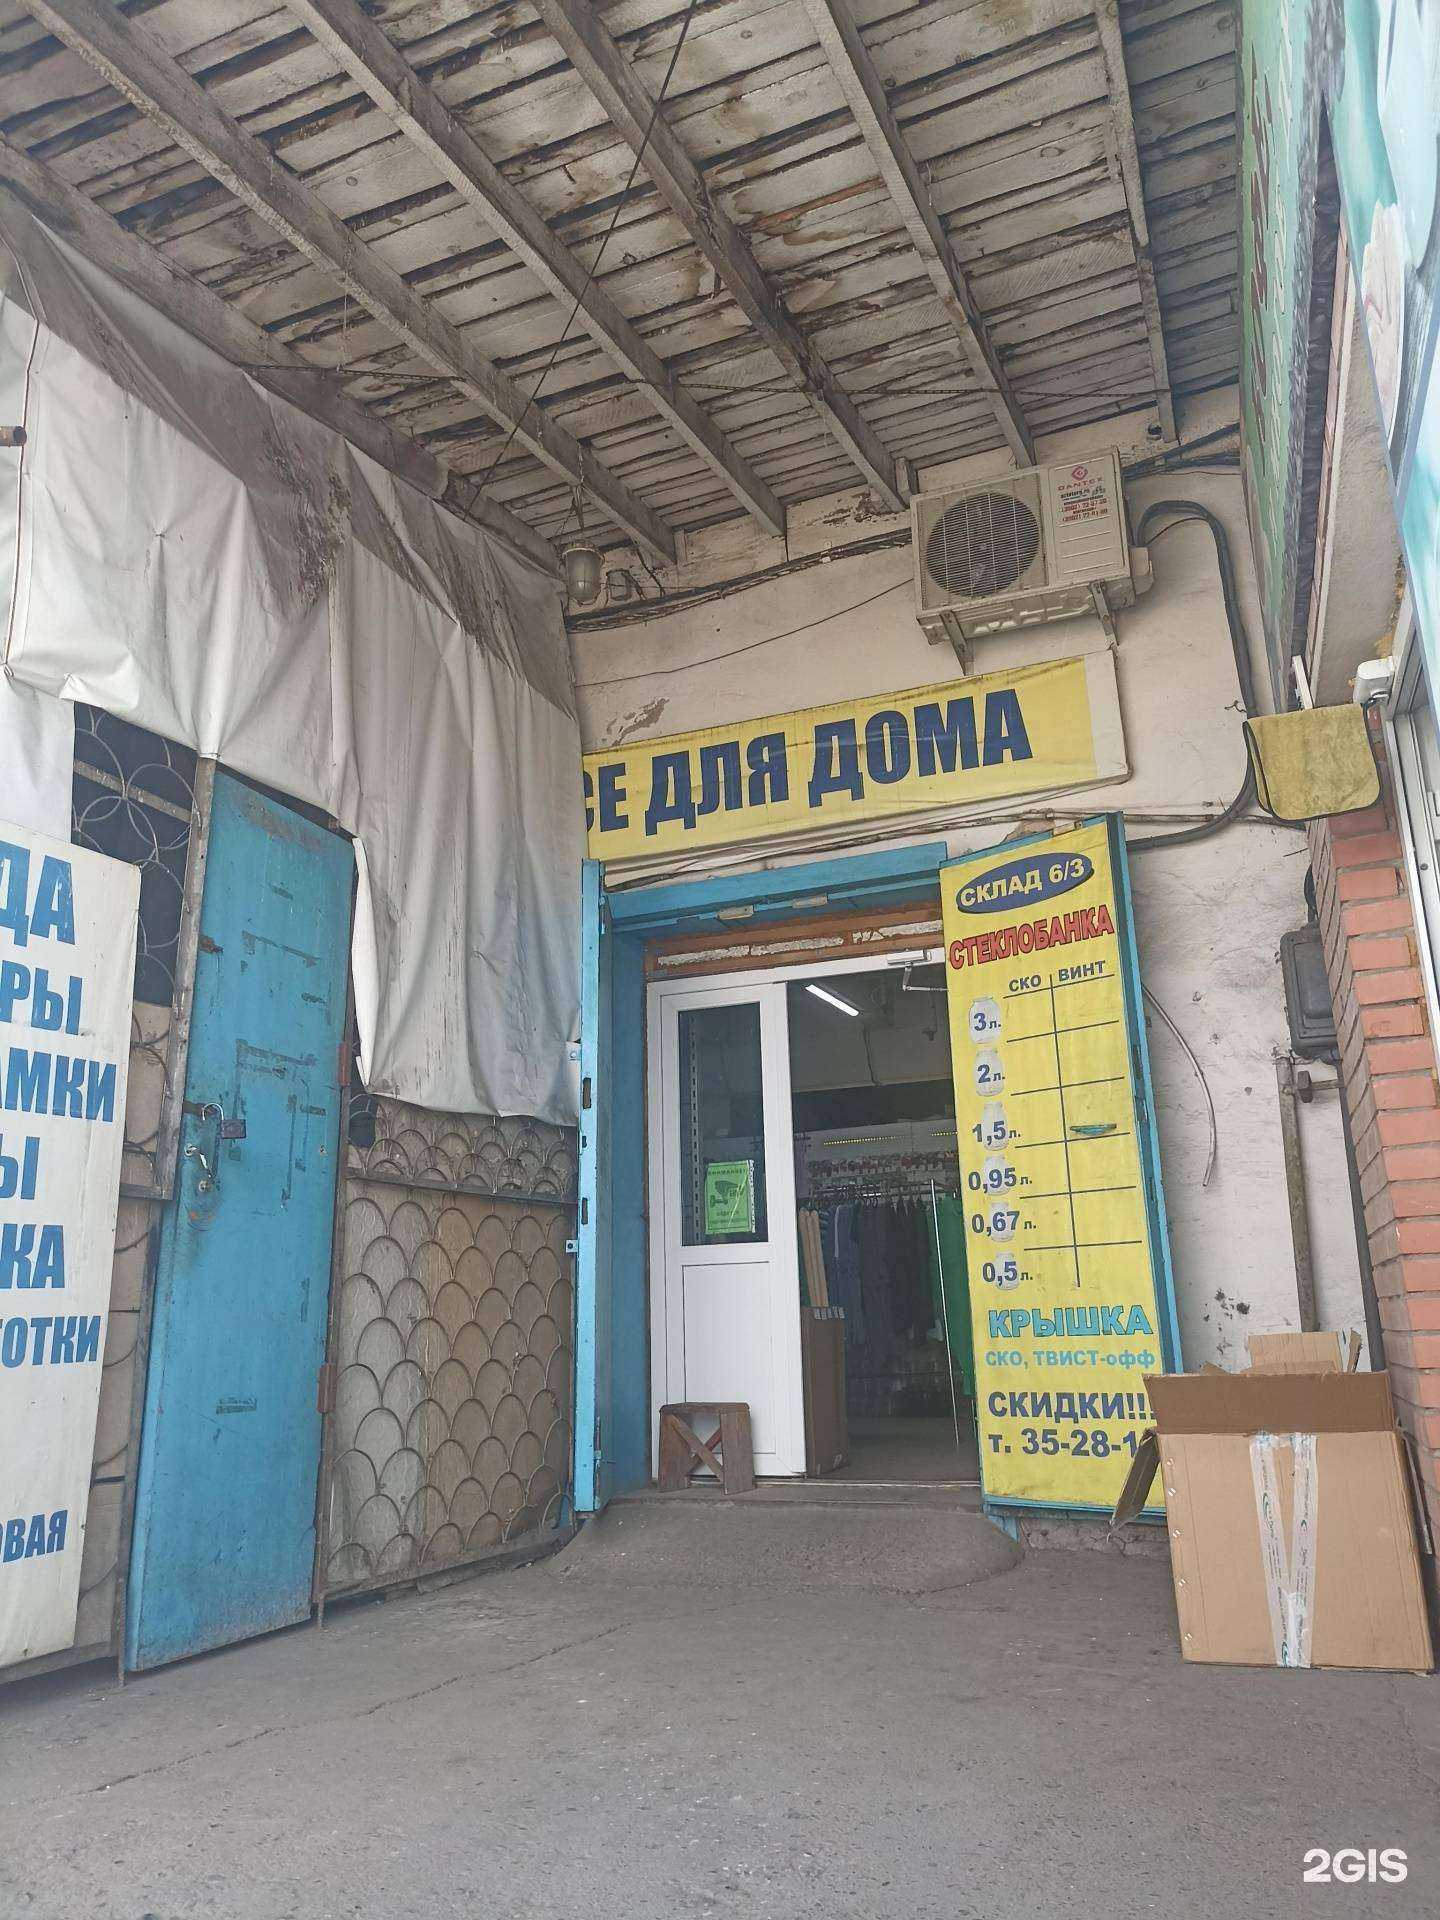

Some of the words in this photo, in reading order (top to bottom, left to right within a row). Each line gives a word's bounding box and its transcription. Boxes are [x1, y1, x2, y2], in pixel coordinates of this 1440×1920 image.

[645, 732, 790, 836] ДЛЯ
[807, 688, 1034, 808] ДОМА
[959, 869, 1044, 907] СКЛАД
[1048, 857, 1087, 883] 6/3
[949, 904, 1115, 970] СТЕКЛОБАНКА
[0, 960, 83, 1035] РЫ
[1008, 974, 1042, 993] СКО
[1057, 960, 1107, 982] ВИНТ
[0, 1046, 117, 1123] МКИ
[0, 1223, 65, 1289] КА
[0, 1315, 101, 1368] ОТКИ
[988, 1304, 1154, 1338] КРЫШКА
[985, 1350, 1028, 1370] СКО,
[988, 1391, 1155, 1424] СКИДКИ!!
[0, 1509, 69, 1563] ВАЯ
